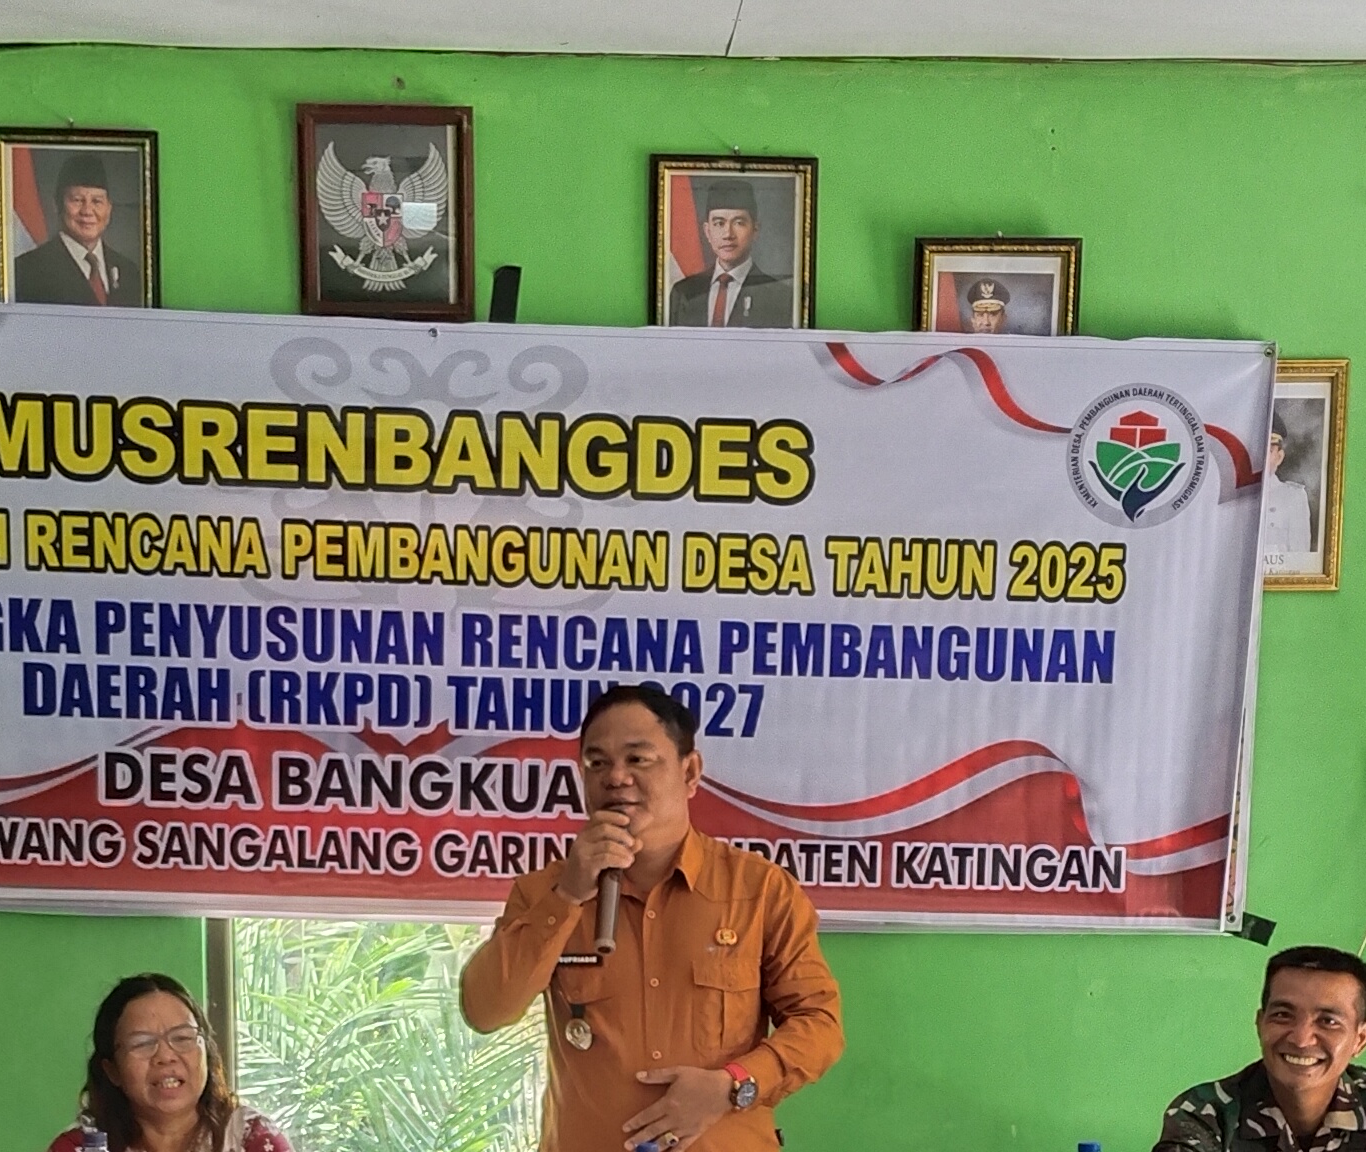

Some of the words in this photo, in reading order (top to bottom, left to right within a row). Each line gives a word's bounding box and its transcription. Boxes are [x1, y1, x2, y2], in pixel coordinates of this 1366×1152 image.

[1079, 389, 1131, 430] PEMBANGUNAN
[1132, 387, 1164, 400] DAERAH
[1194, 435, 1205, 453] DAN
[1071, 455, 1098, 509] KEMENTERIAN
[1172, 455, 1205, 511] TRANSMIGRASI
[24, 508, 270, 579] RENCANA
[281, 519, 670, 592] PEMBANGUNAN
[683, 532, 813, 597] DESA
[826, 537, 999, 599] TAHUN
[1008, 539, 1126, 602] 2025
[97, 601, 444, 666] PENYUSUNAN
[461, 613, 704, 674] RENCANA
[719, 620, 1116, 684] PEMBANGUNAN
[23, 662, 231, 722] DAERAH
[248, 669, 432, 730] (RKPD)
[642, 680, 765, 738] 027
[103, 750, 255, 806] DESA
[278, 756, 585, 815] BANGKUA
[136, 825, 418, 874] SANGALANG
[434, 833, 574, 875] GARIN
[895, 846, 1124, 891] KATINGAN
